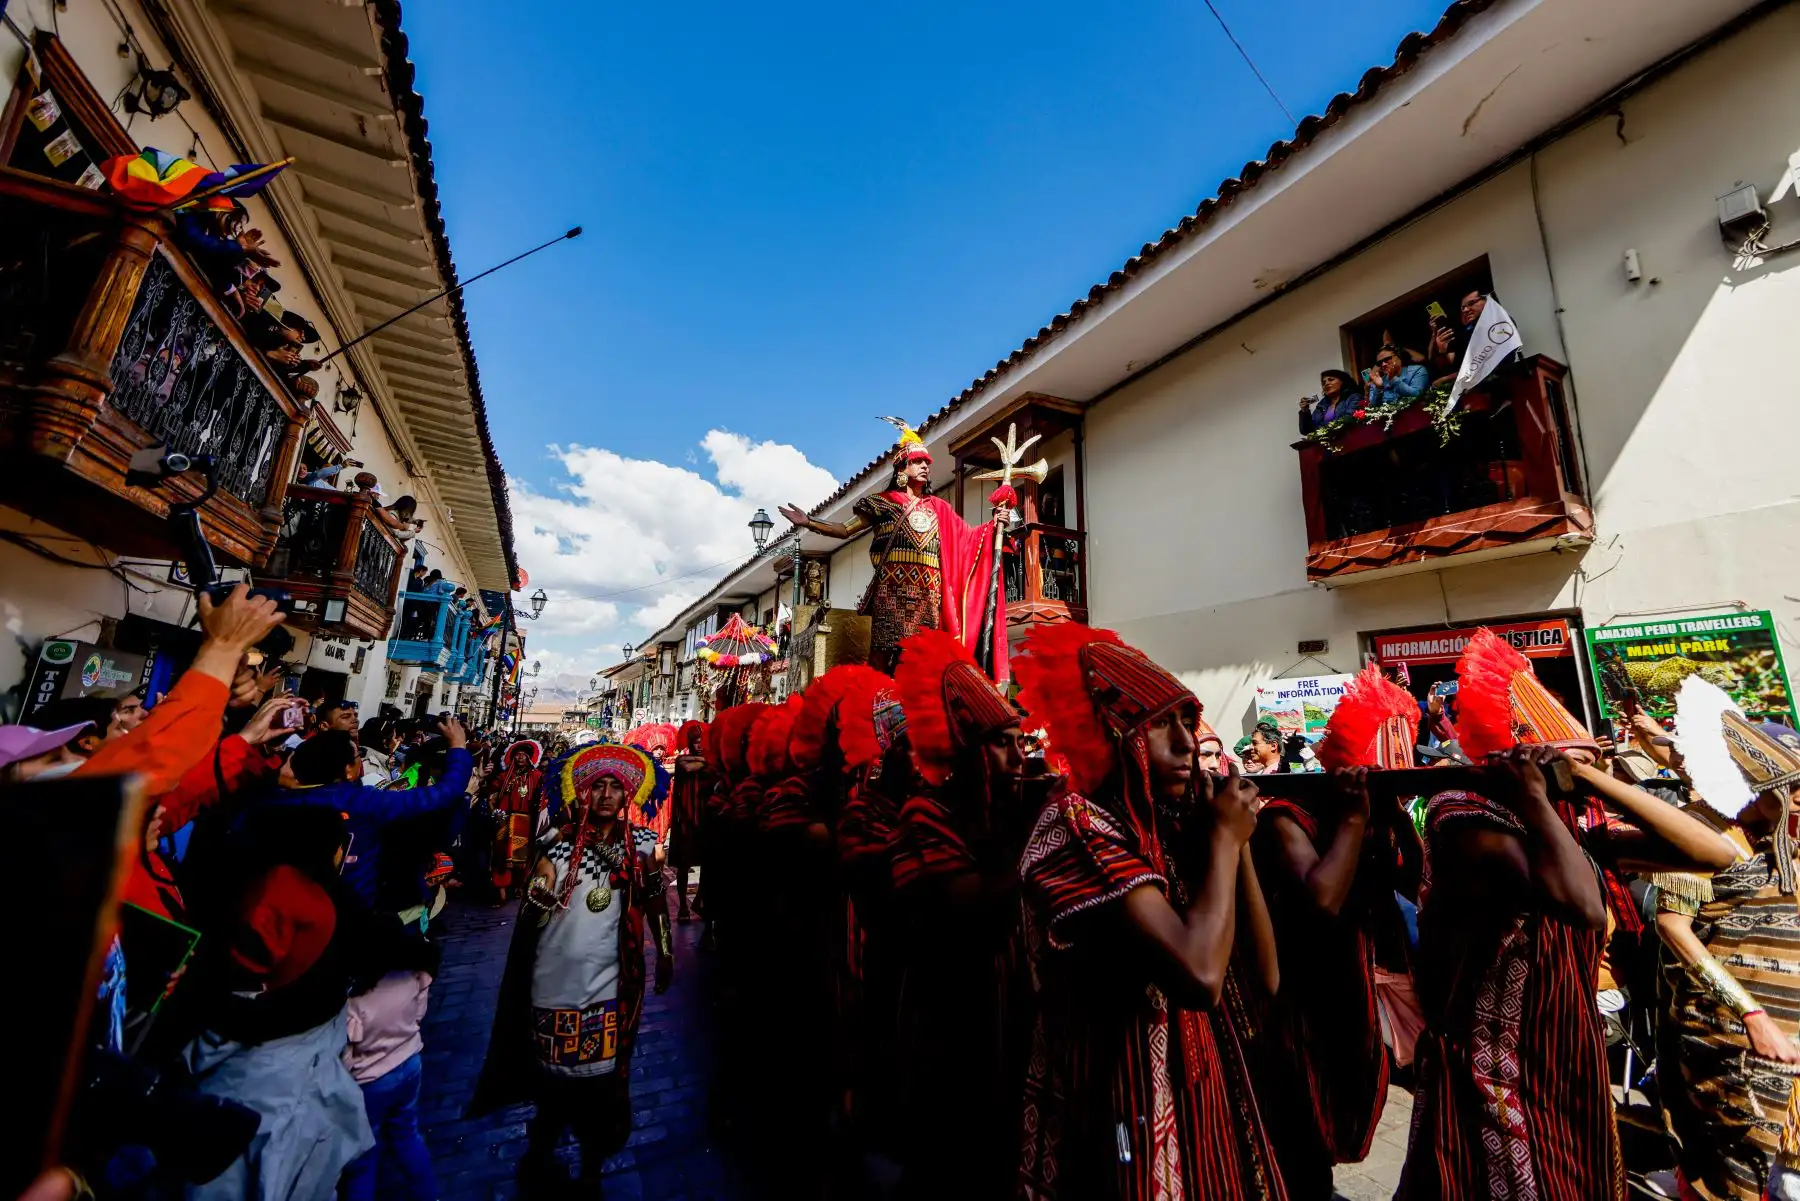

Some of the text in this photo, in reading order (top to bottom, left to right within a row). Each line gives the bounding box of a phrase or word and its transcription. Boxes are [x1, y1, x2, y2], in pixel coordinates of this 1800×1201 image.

[1595, 615, 1762, 640] AMAZON PERU TRAVELLERS
[1496, 627, 1564, 649] ÍSTICA
[1626, 639, 1730, 657] MANU PARK
[1277, 687, 1344, 699] INFORMATION
[1297, 680, 1319, 689] FREE
